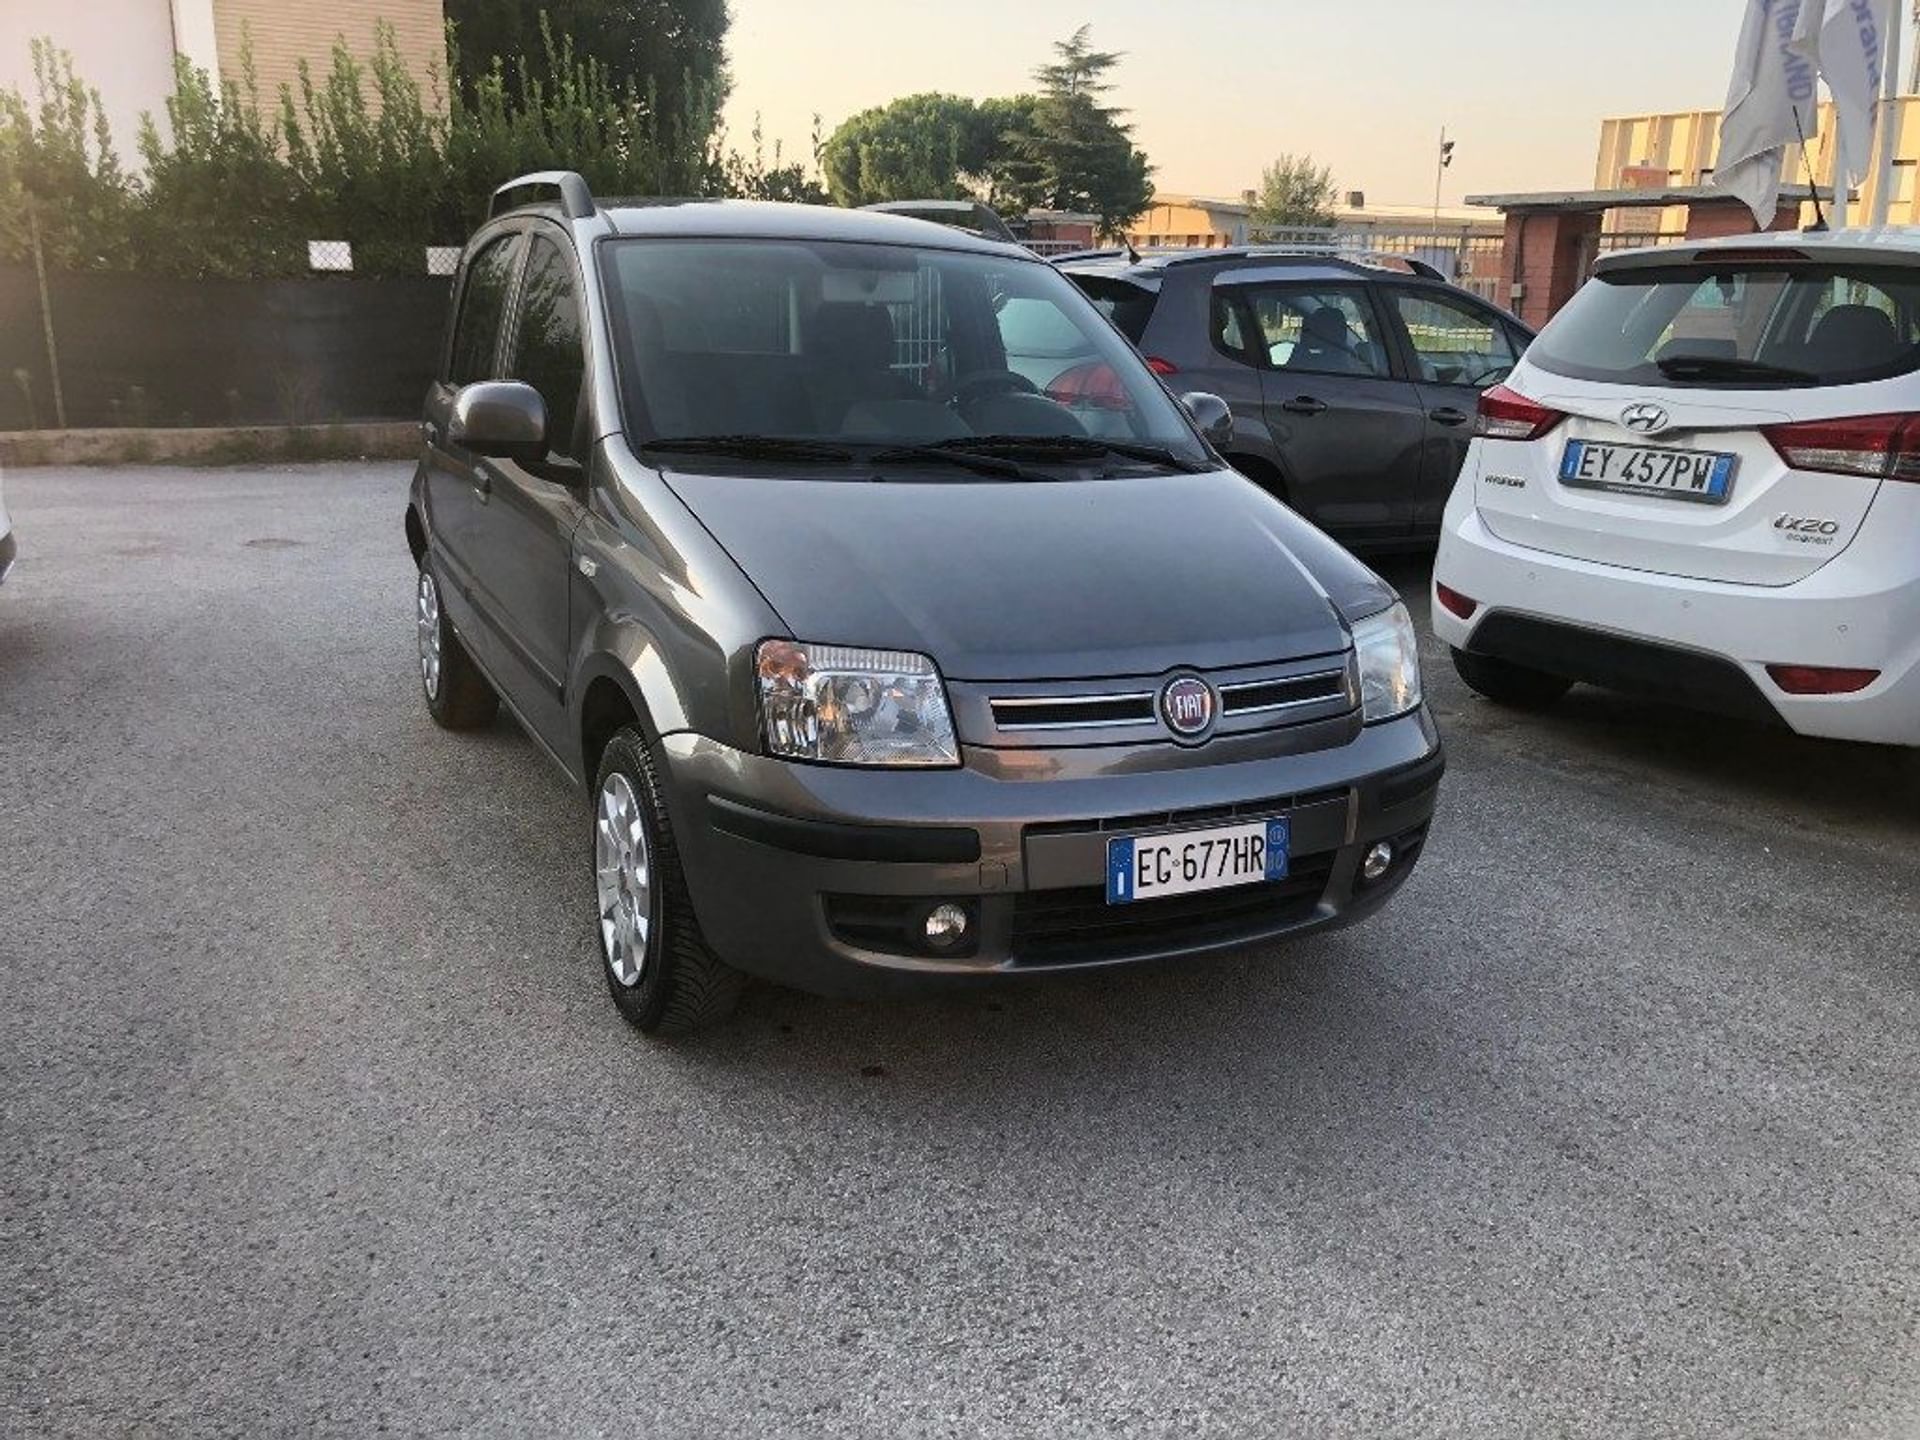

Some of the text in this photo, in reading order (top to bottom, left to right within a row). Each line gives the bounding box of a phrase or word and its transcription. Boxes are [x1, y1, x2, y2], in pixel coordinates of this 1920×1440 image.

[1579, 446, 1615, 478] EY
[1620, 451, 1712, 490] 457PW
[1774, 513, 1839, 534] ix20
[1175, 693, 1203, 720] FIAT
[1138, 847, 1172, 888] EG
[1182, 834, 1265, 882] 677HR
